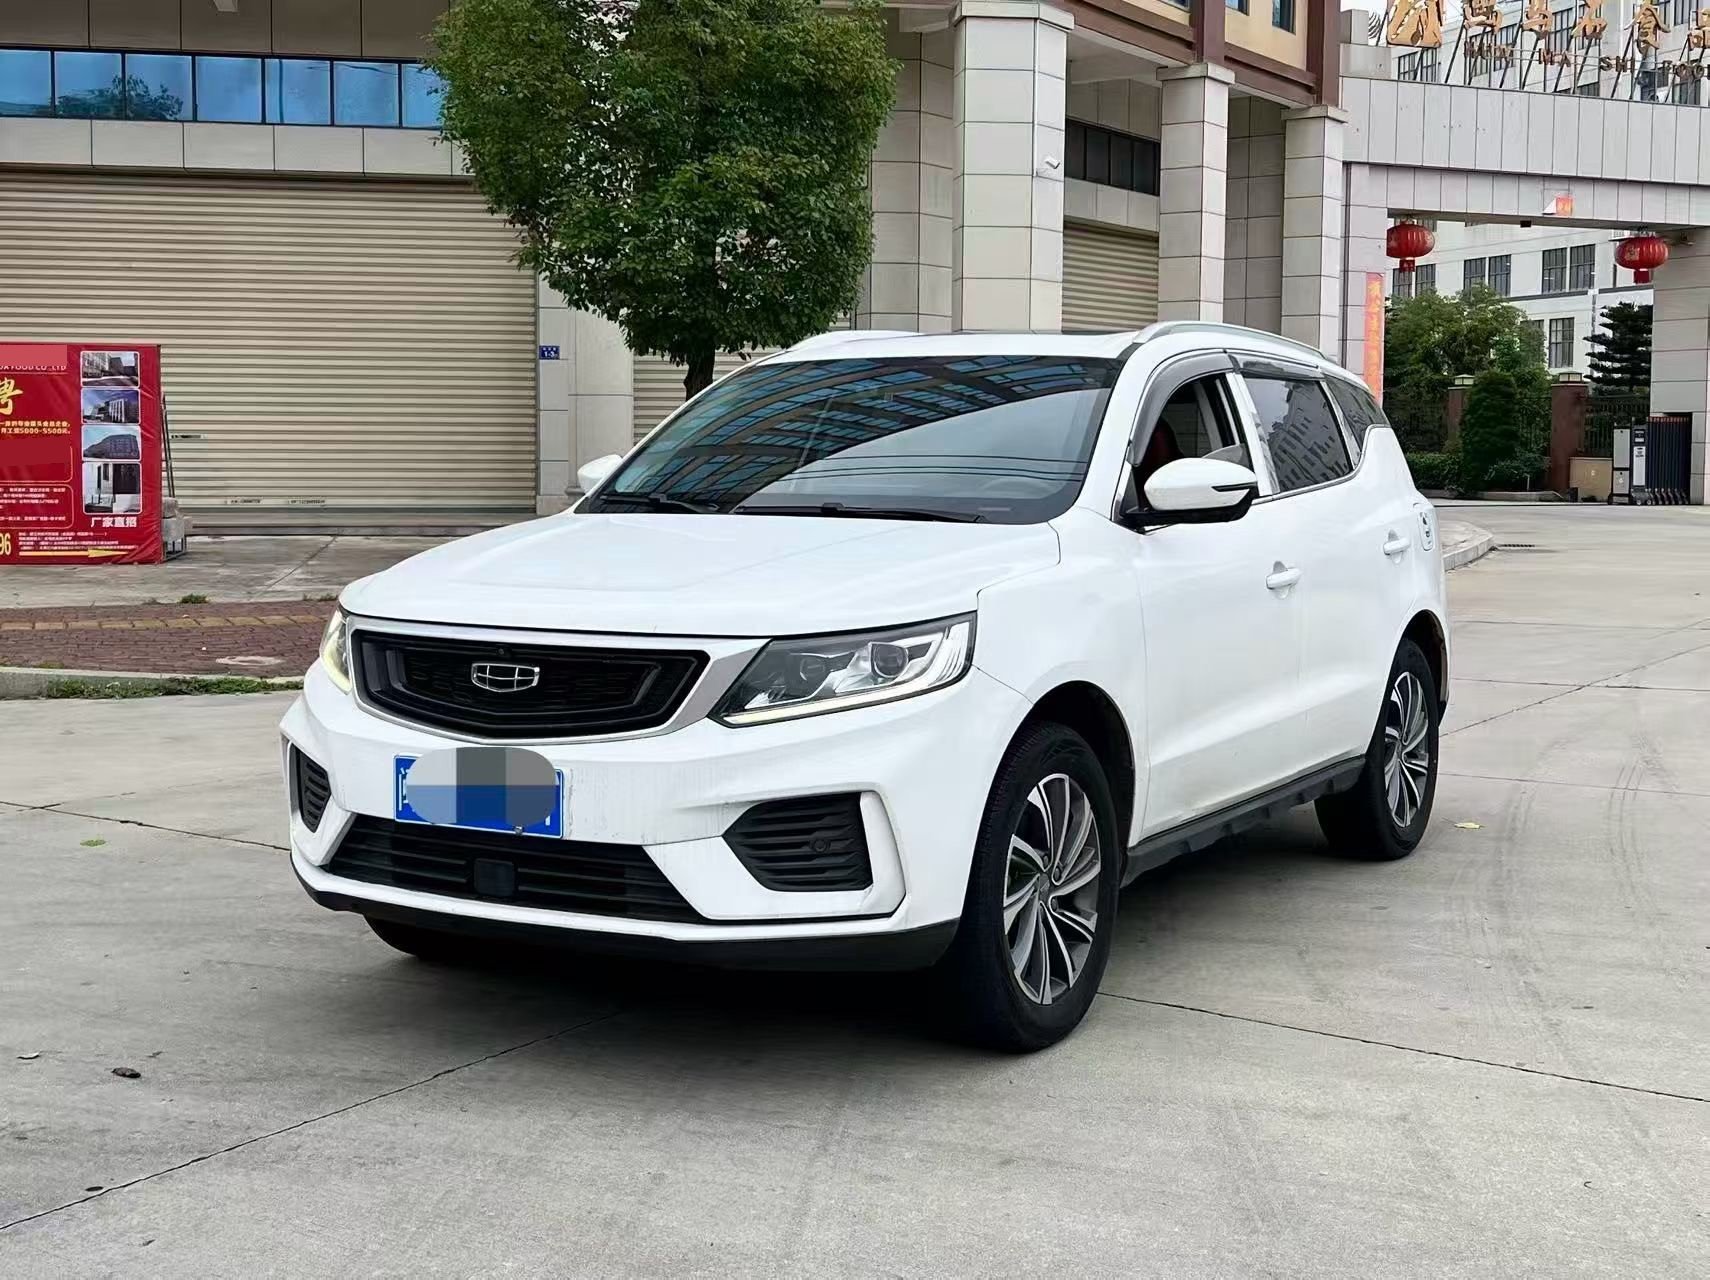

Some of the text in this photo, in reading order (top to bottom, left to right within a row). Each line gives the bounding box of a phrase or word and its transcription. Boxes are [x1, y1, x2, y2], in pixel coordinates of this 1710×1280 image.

[1599, 55, 1636, 73] SHI
[91, 516, 137, 528] 厂家直招
